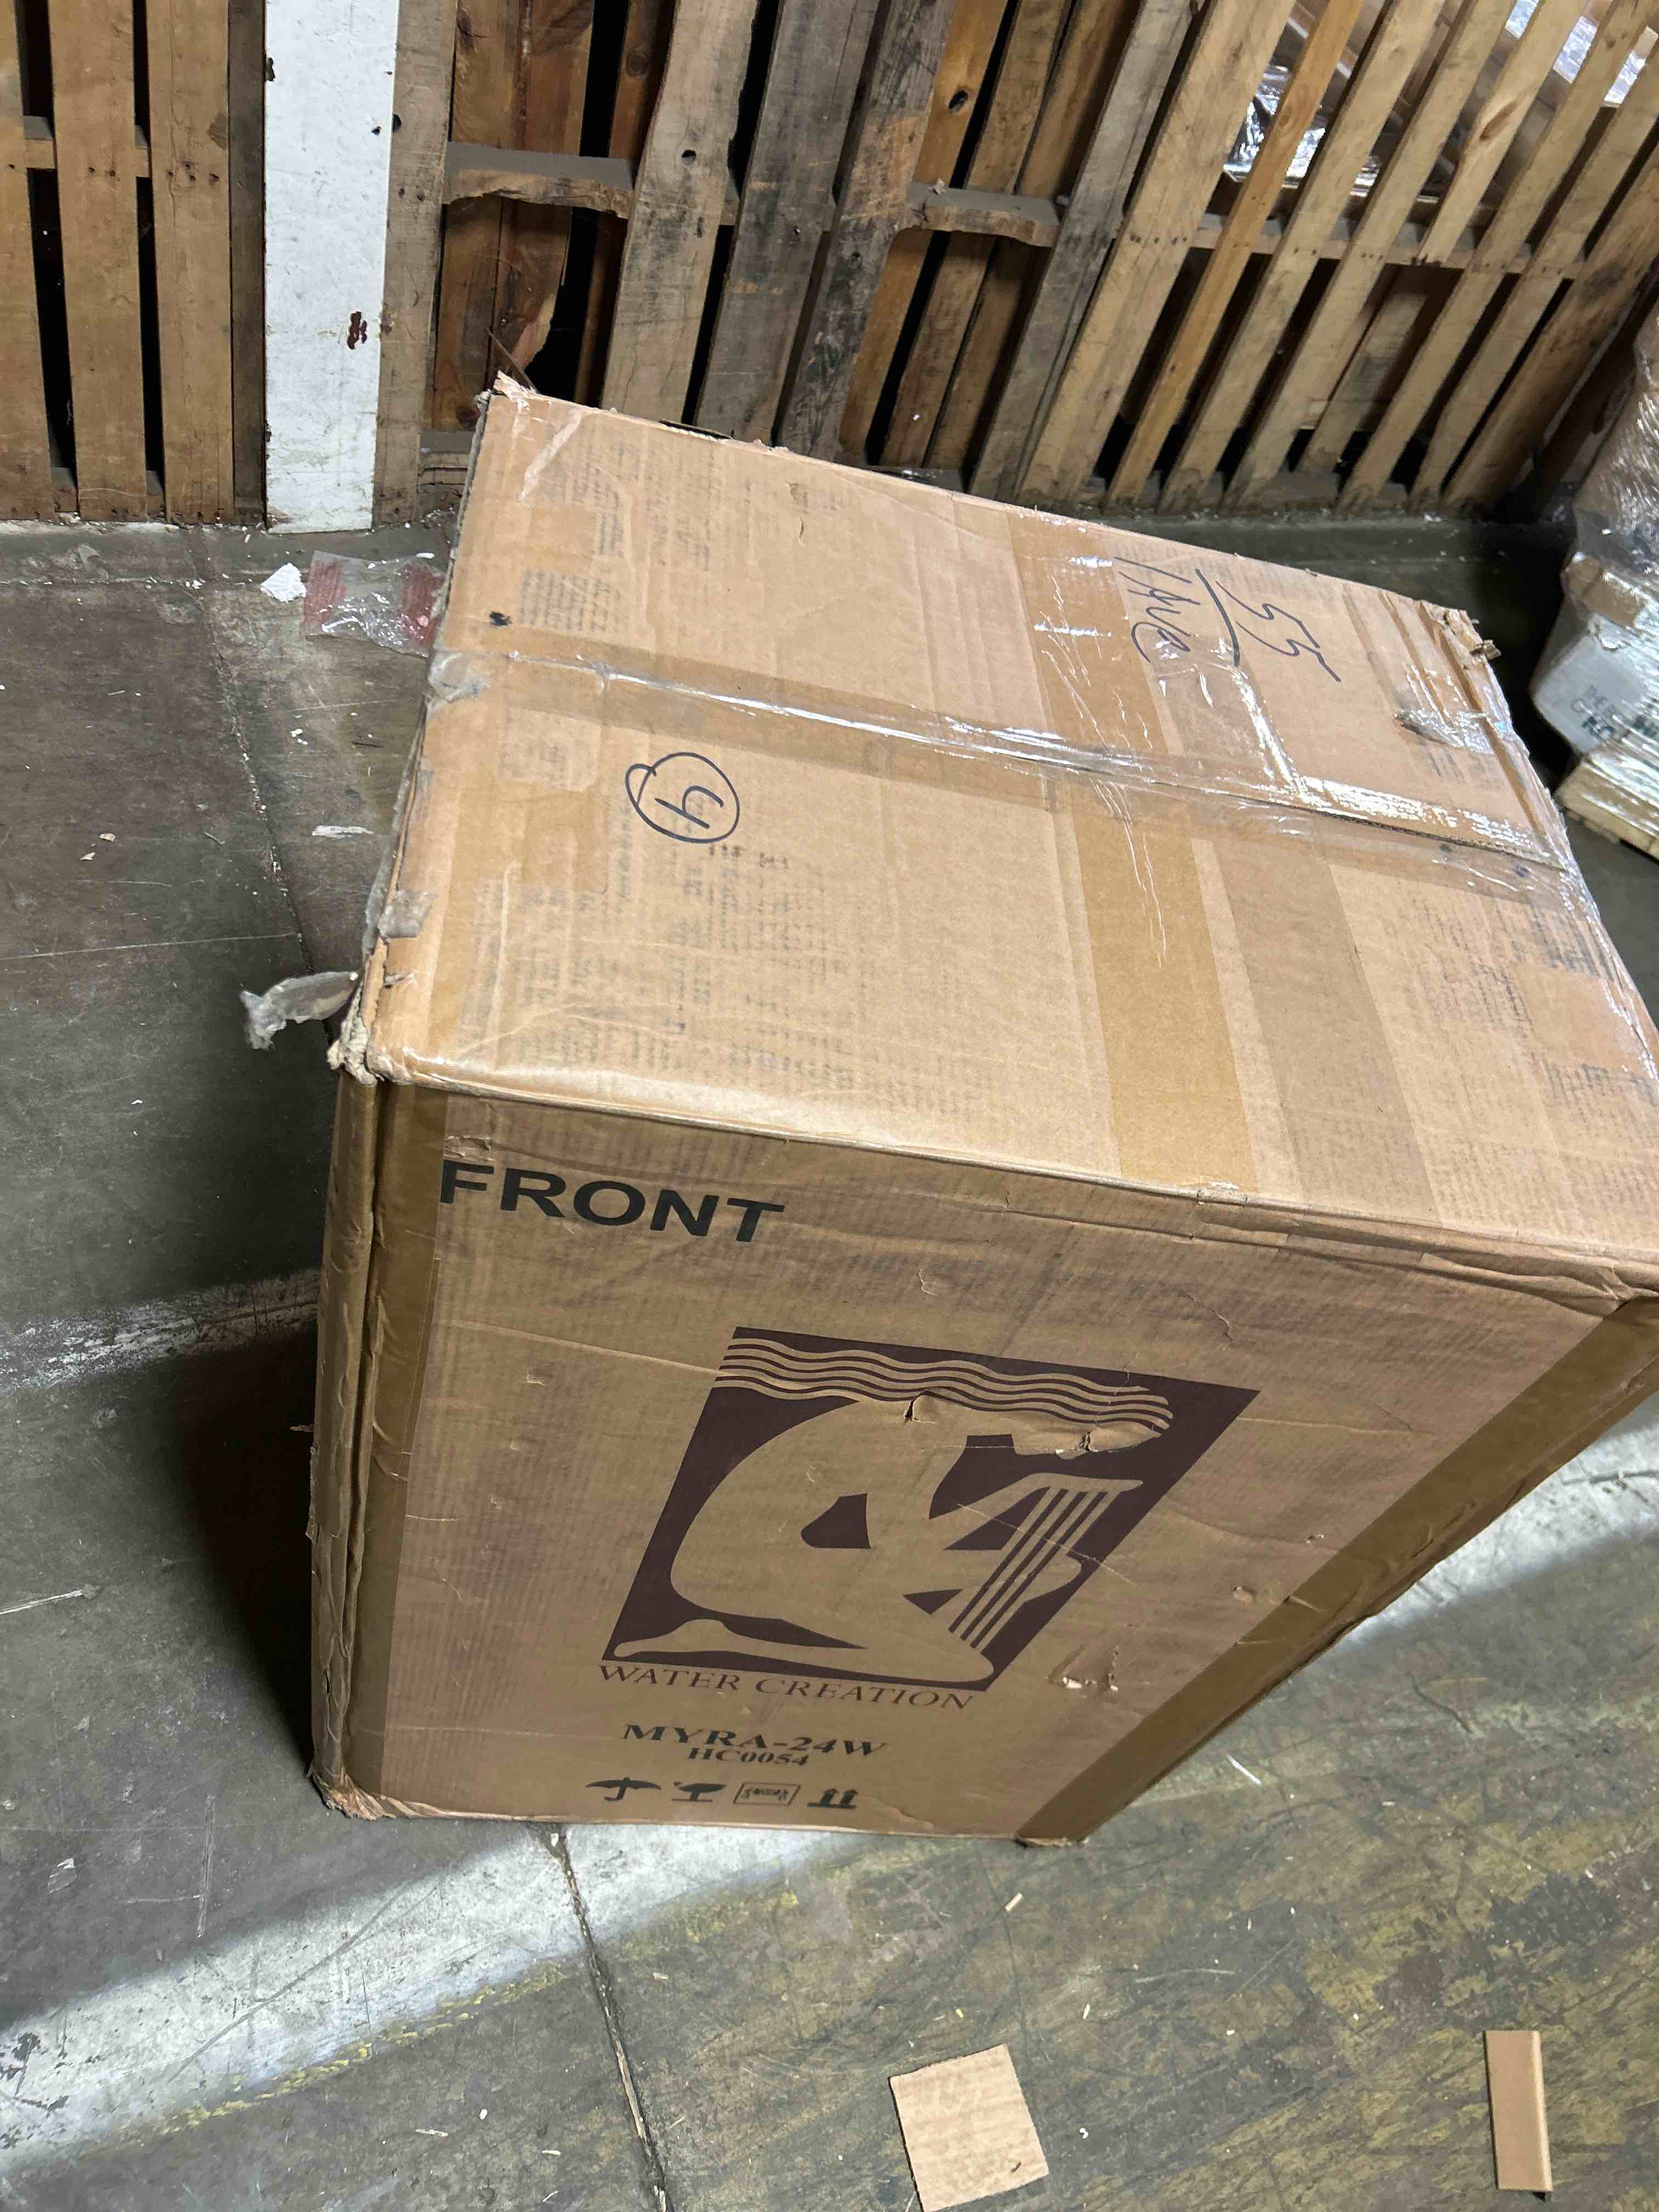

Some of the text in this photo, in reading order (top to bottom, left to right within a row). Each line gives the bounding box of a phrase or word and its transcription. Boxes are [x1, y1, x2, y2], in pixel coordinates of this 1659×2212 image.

[439, 1159, 786, 1243] FRONT
[598, 1664, 974, 1709] WATER CREATION
[623, 1724, 887, 1757] MYRA-24W
[687, 1747, 810, 1766] HC0054
